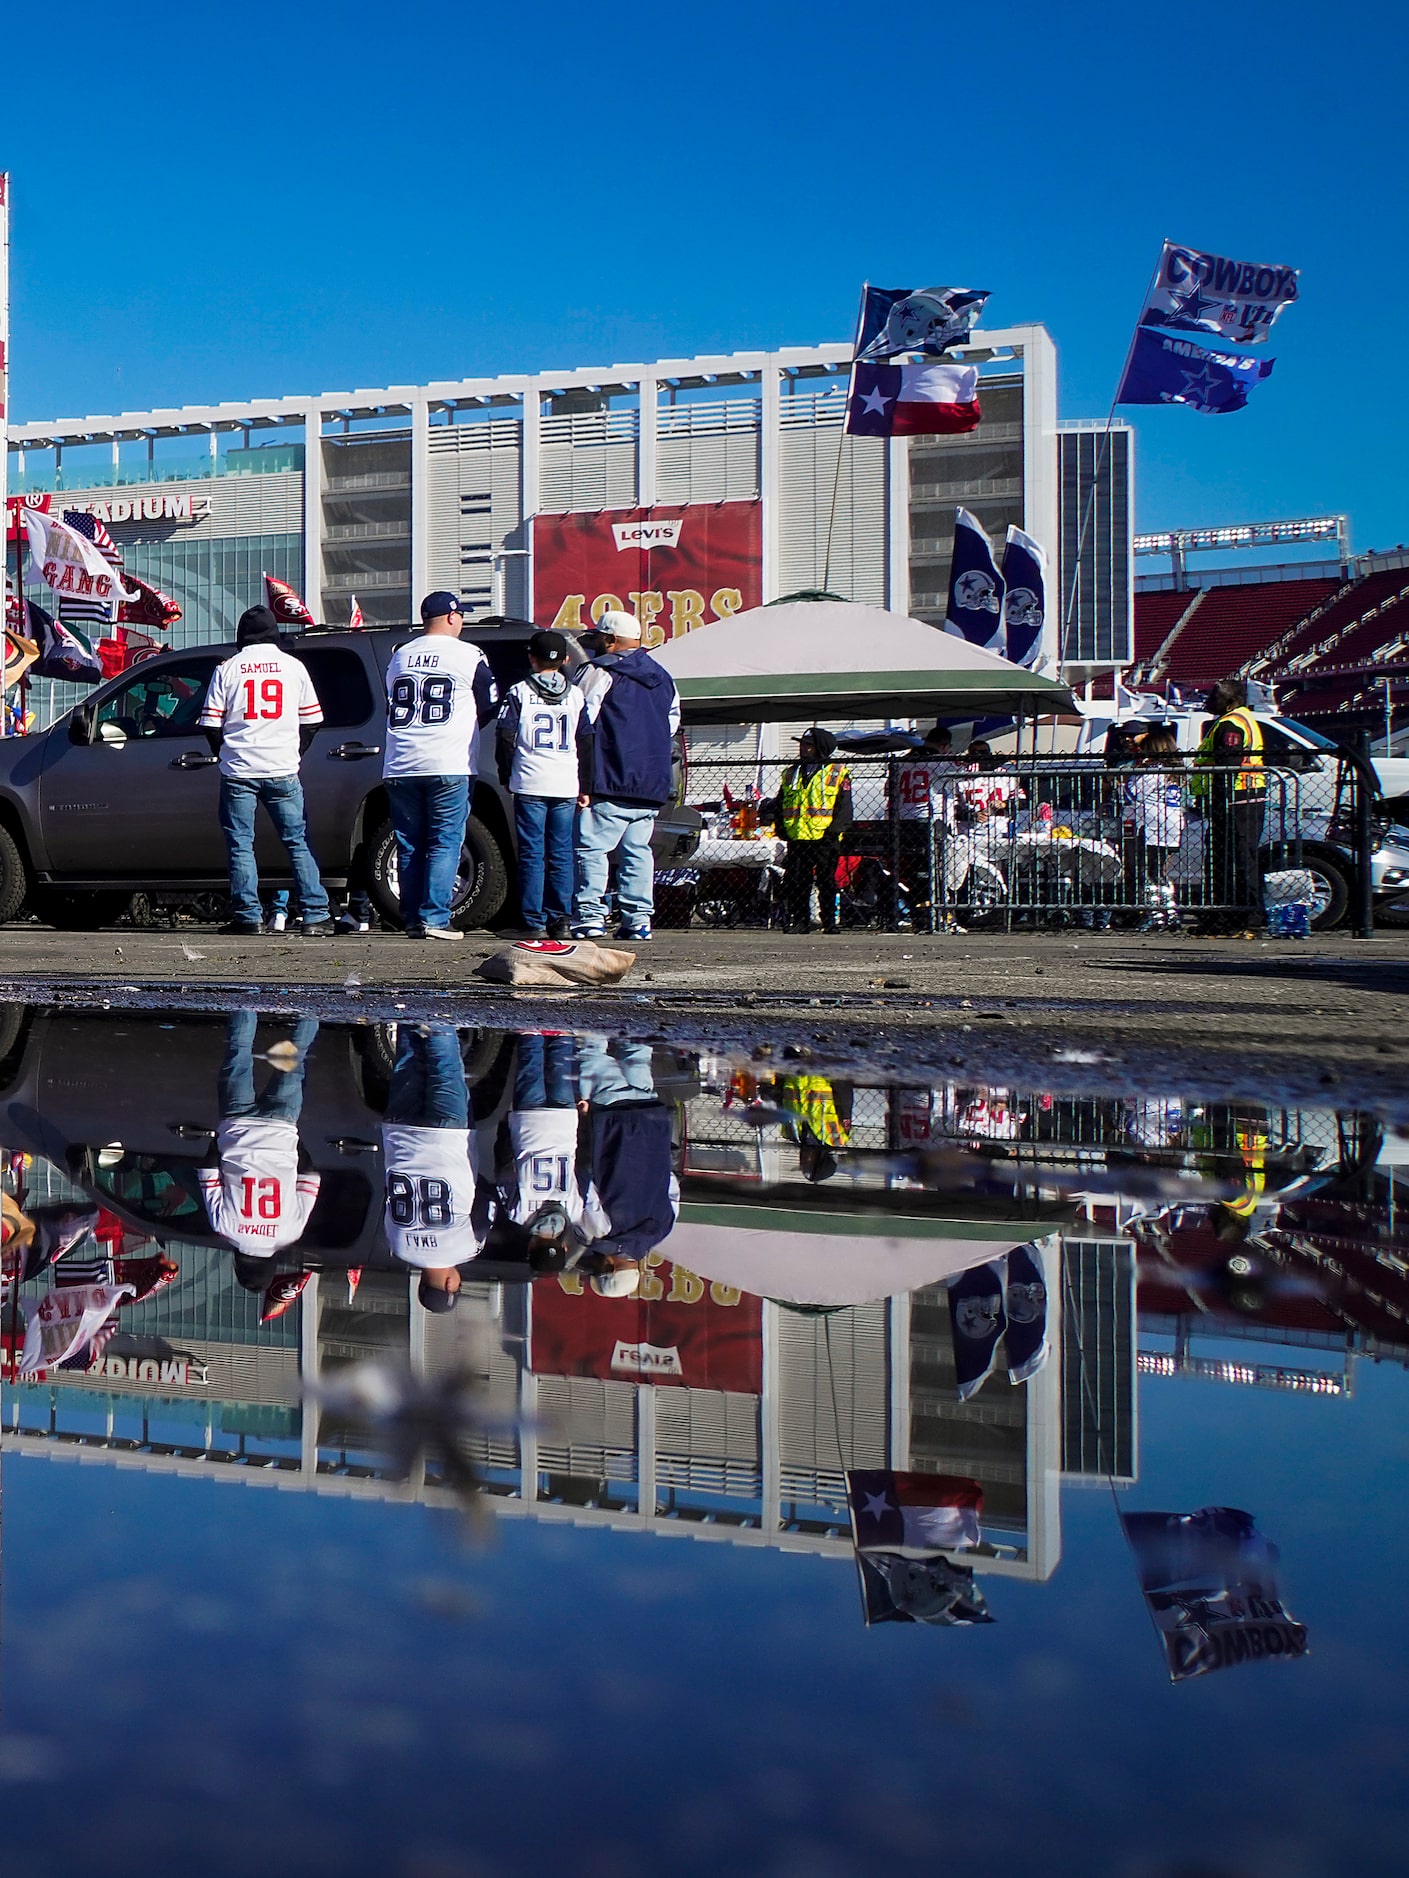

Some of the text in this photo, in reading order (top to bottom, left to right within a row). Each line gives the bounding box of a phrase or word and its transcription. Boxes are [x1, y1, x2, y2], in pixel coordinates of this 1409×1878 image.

[1166, 248, 1298, 298] COWBOYS
[60, 494, 193, 523] ADIUM
[42, 561, 113, 597] GANG
[240, 662, 282, 674] SAMUEL
[407, 655, 439, 668] LAMB
[243, 679, 284, 720] 19
[389, 674, 456, 730] 88
[531, 713, 571, 754] 21
